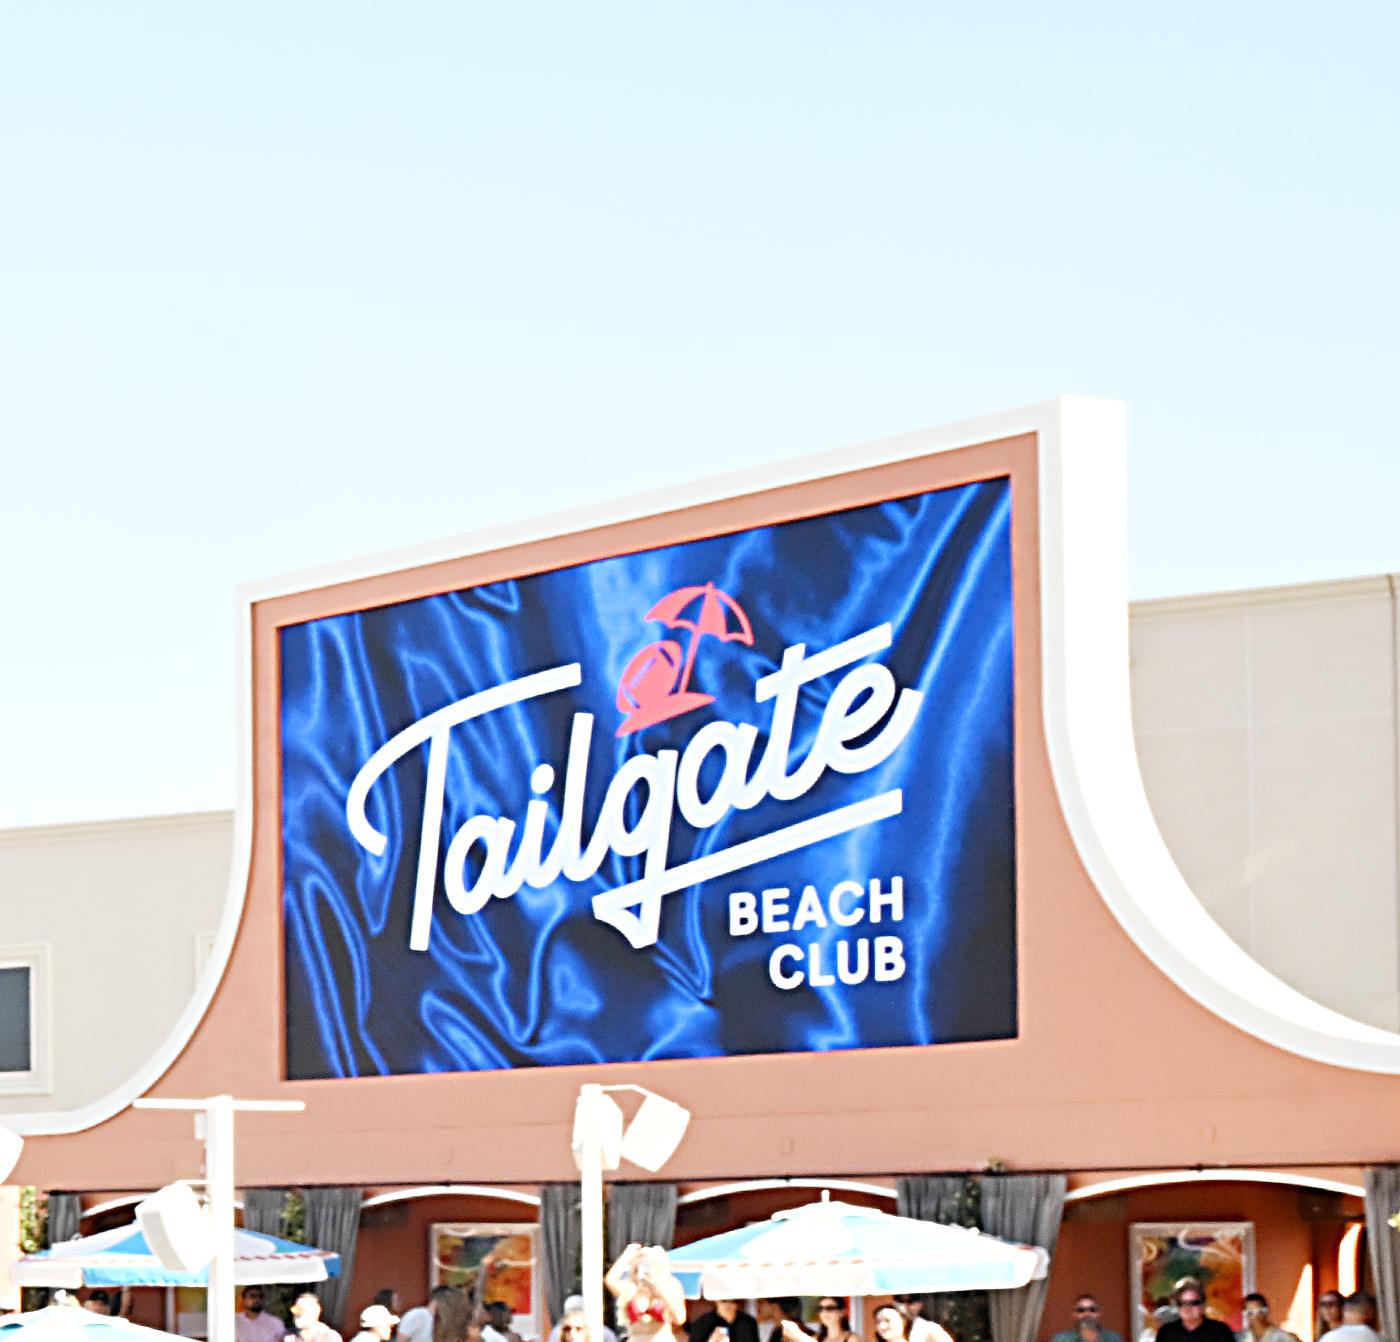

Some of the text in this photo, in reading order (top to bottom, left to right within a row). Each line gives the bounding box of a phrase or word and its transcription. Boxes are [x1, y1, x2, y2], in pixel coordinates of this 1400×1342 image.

[346, 622, 923, 951] Tailgate
[729, 876, 905, 938] BEACH
[769, 935, 906, 991] CLUB
